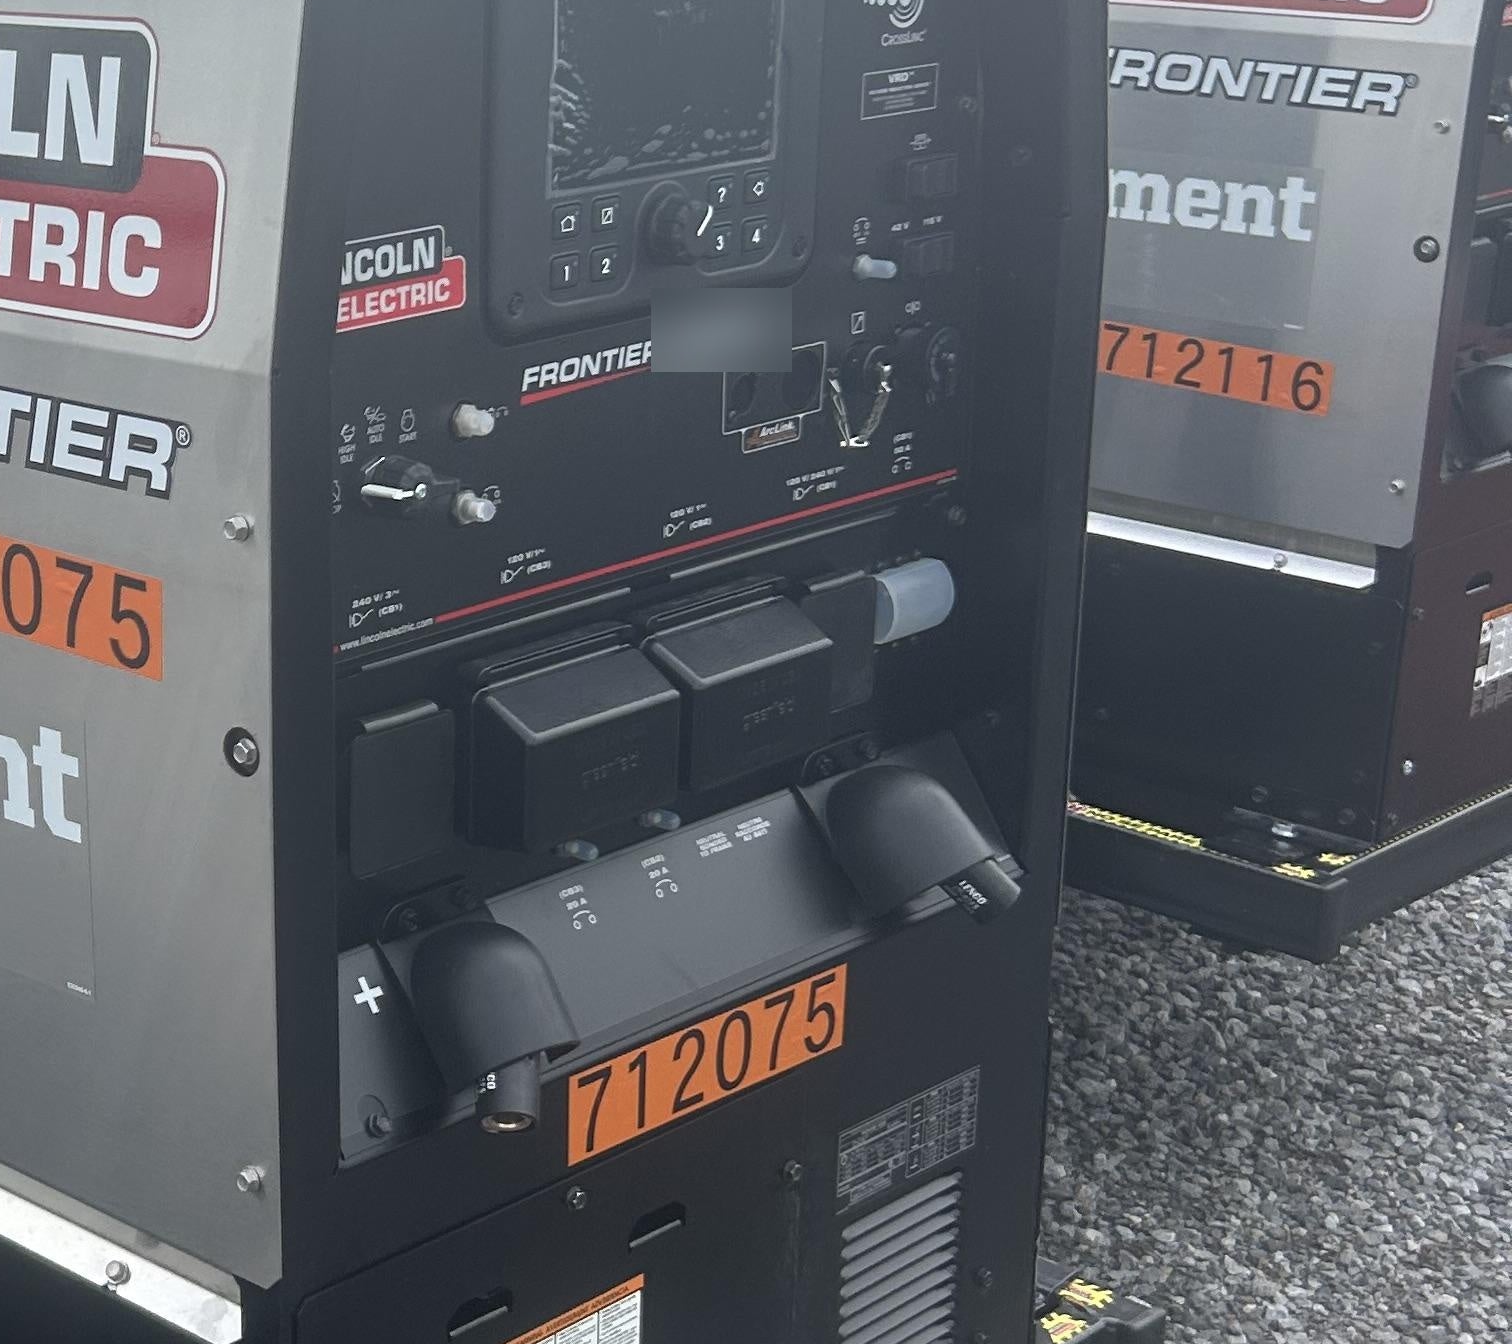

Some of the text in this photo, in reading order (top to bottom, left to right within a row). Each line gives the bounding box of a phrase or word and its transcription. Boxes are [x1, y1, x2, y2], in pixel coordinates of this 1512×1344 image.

[1108, 47, 1407, 114] RONTIER
[715, 235, 725, 250] 3
[751, 228, 762, 243] 4
[564, 265, 571, 281] 1
[601, 258, 611, 274] 2
[337, 276, 451, 323] ELECTRIC
[1103, 323, 1324, 411] 712116
[577, 971, 837, 1154] 712075
